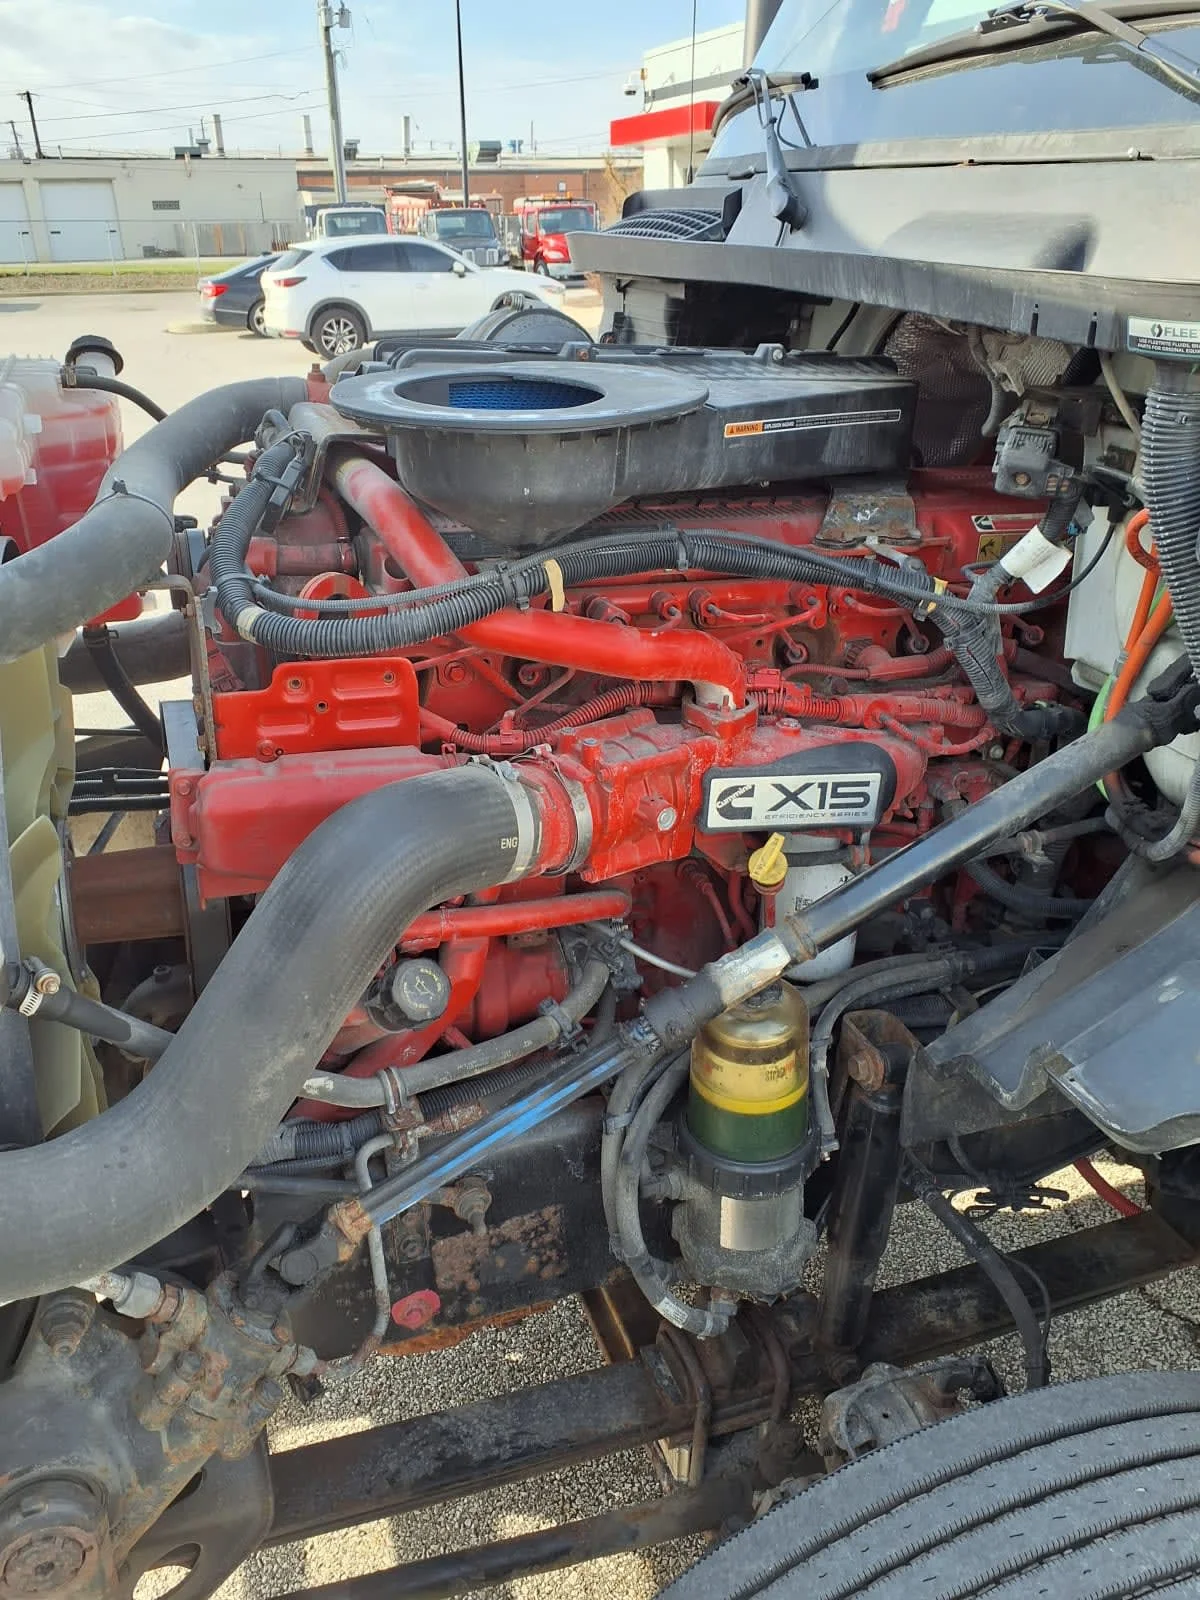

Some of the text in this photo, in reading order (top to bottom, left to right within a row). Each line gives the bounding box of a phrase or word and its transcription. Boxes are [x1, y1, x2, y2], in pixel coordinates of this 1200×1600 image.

[1164, 327, 1200, 338] FLEE
[735, 423, 760, 432] WARNING
[768, 780, 871, 811] X15
[764, 812, 826, 820] EFFICIENCY
[501, 837, 518, 849] ENG
